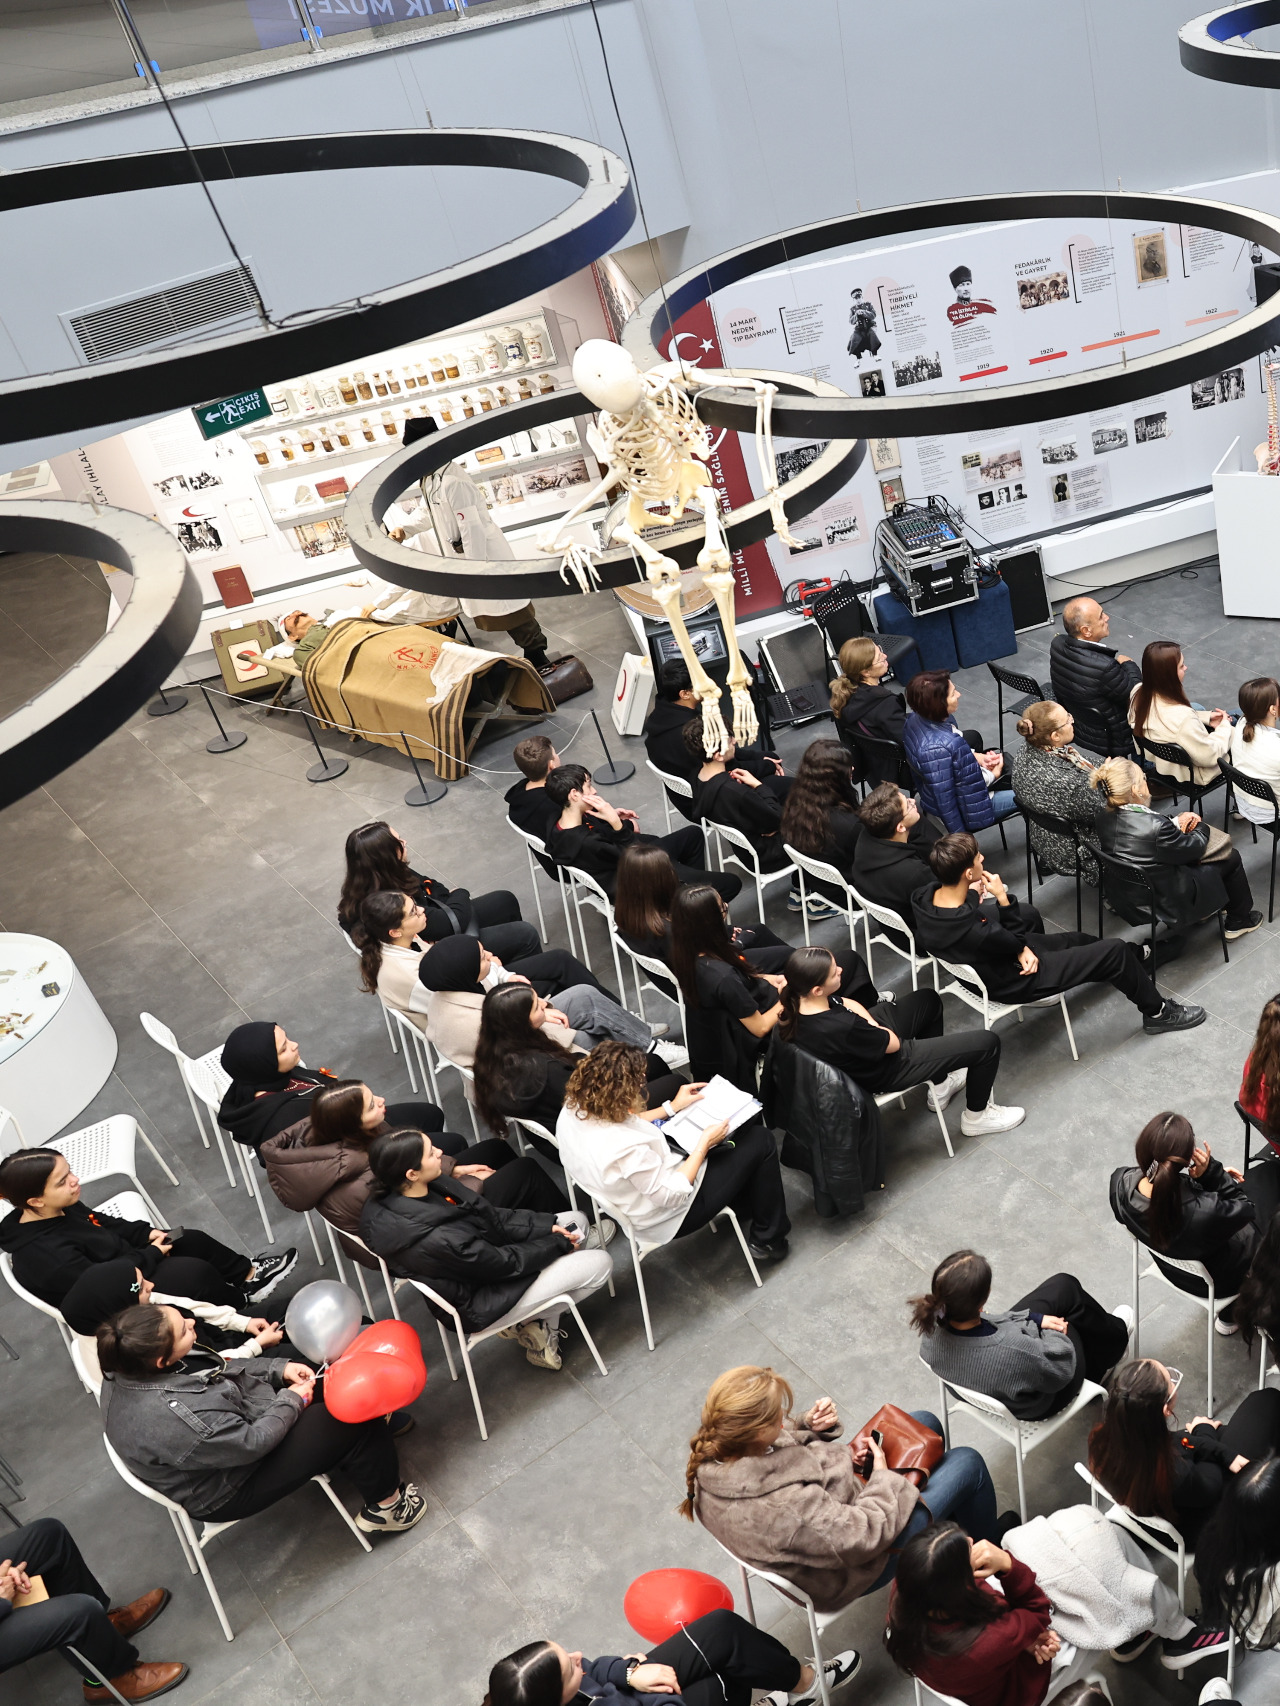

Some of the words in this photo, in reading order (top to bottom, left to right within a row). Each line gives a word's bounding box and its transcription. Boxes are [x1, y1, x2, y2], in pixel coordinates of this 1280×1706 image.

[1015, 257, 1051, 270] FEDAKÂRLIK
[1025, 265, 1048, 275] GAYRET
[889, 293, 919, 304] TIBBİYELİ
[890, 301, 914, 311] HİKMET
[738, 316, 757, 326] MART
[731, 326, 754, 335] NEDEN
[745, 328, 777, 340] BAYRAMI?
[235, 392, 260, 406] ÇIKIŞ
[239, 400, 261, 414] EXIT
